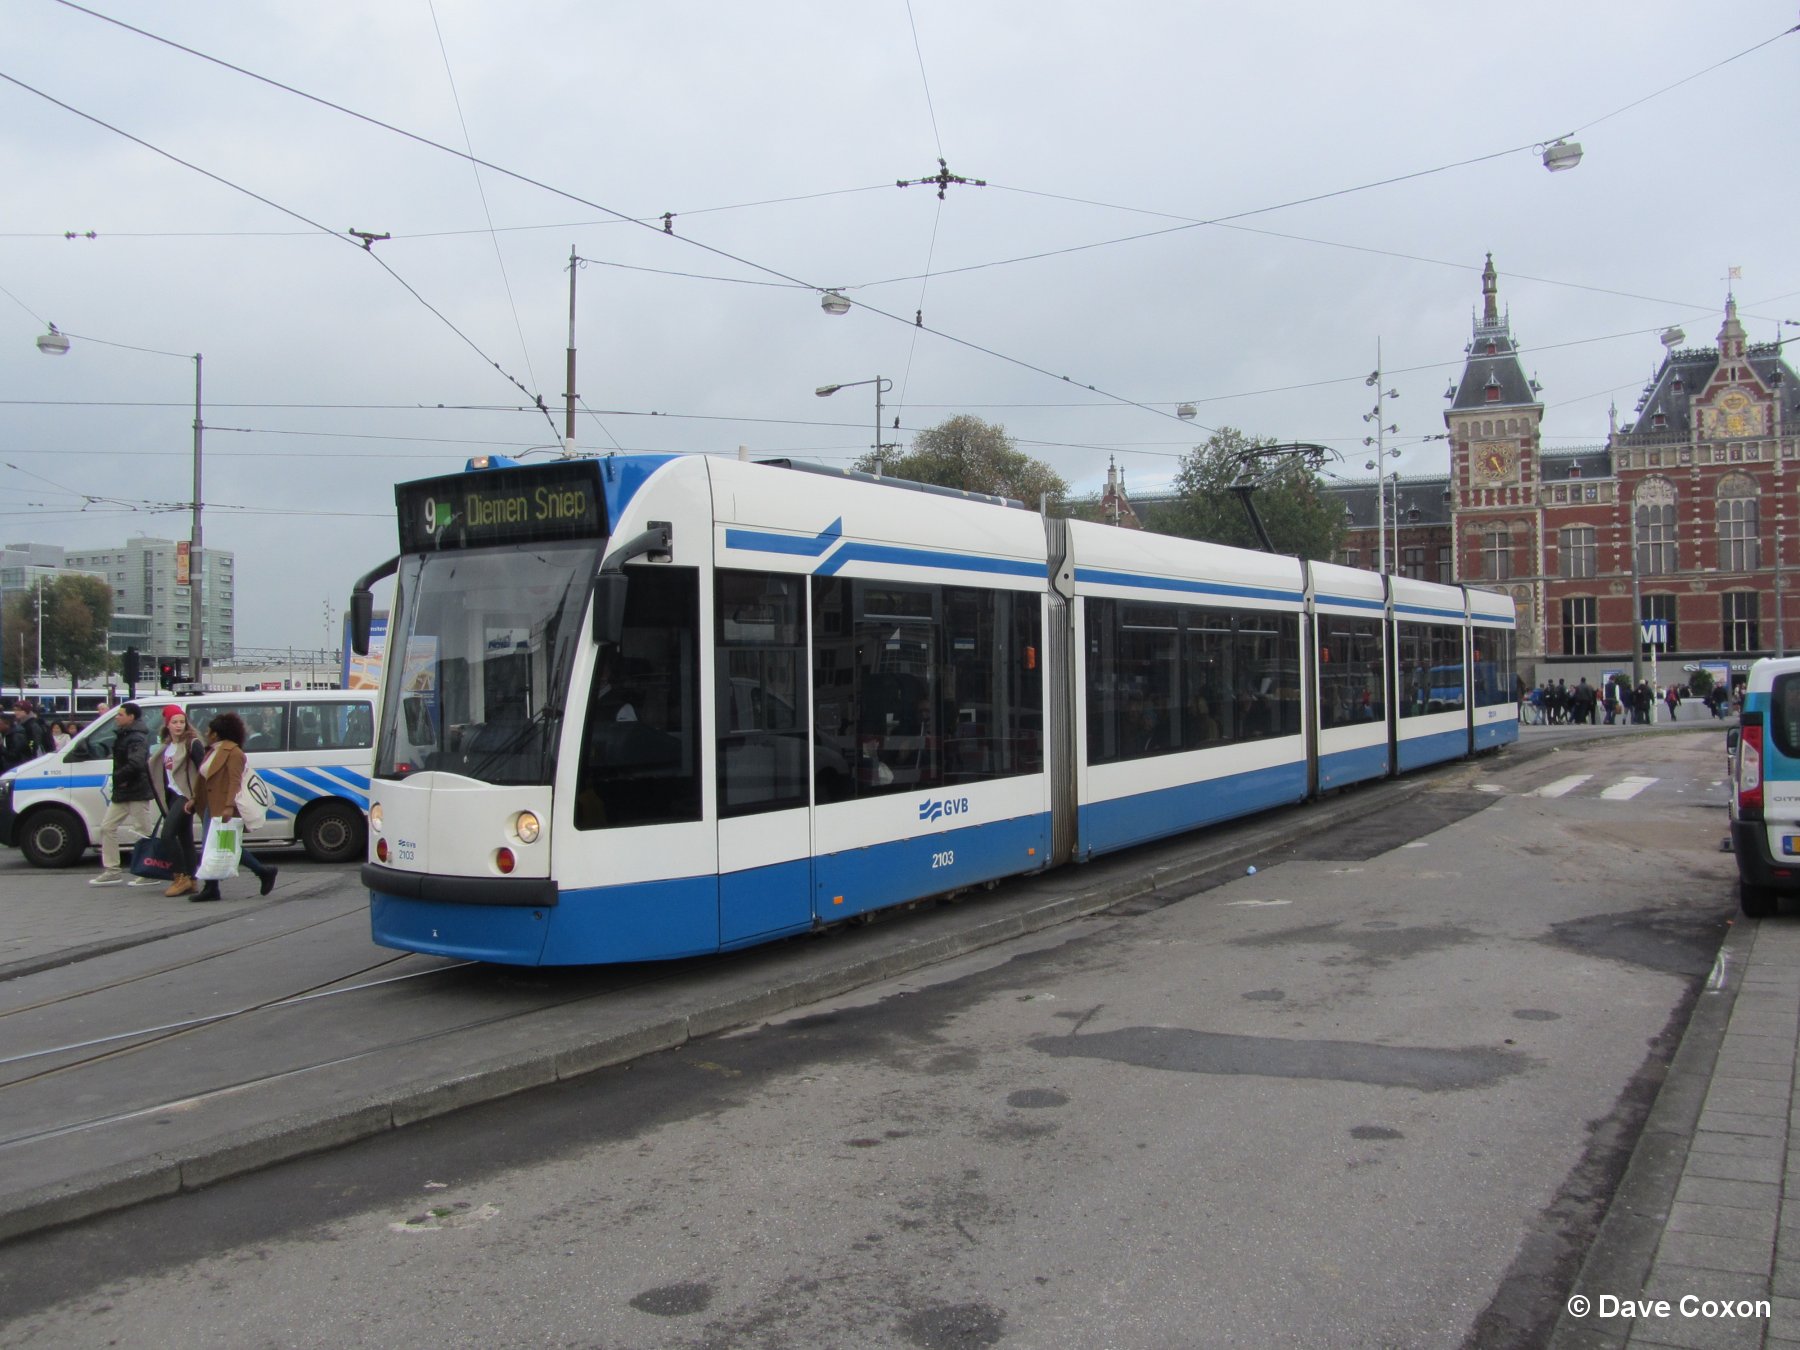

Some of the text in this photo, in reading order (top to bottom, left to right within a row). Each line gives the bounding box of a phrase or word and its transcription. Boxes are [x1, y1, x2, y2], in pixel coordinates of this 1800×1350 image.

[424, 486, 586, 535] 9 Diemen Sniep
[944, 797, 969, 816] GVB
[144, 856, 173, 870] ONLY
[398, 849, 415, 861] 2103
[931, 850, 954, 869] 2103
